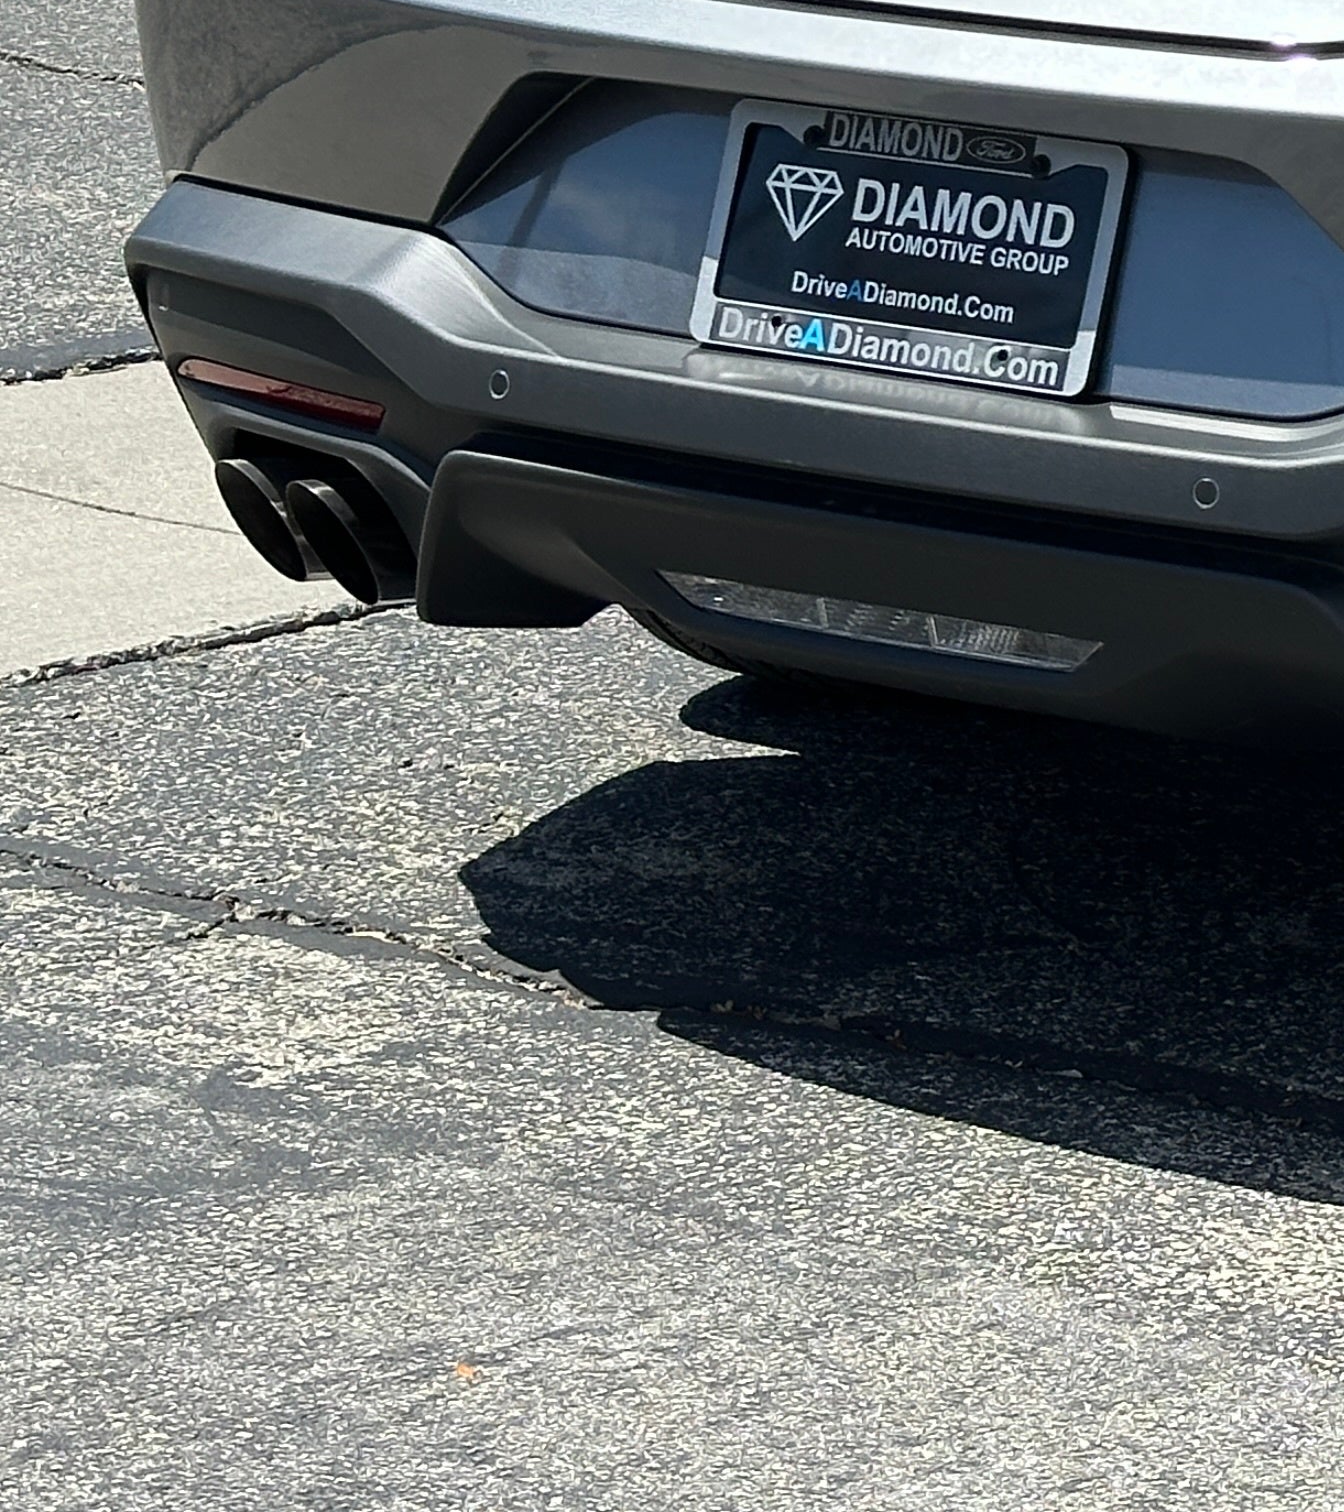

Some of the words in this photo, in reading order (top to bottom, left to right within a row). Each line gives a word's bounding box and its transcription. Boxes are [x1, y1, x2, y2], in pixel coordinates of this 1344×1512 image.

[828, 112, 964, 162] DIAMOND
[976, 139, 1016, 160] Ford
[851, 177, 1075, 248] DIAMOND
[845, 226, 984, 266] AUTOMOTIVE
[990, 246, 1070, 276] GROUP
[791, 270, 1015, 324] DriveADiamond.Com
[718, 306, 1060, 387] DriveADiamond.Com
